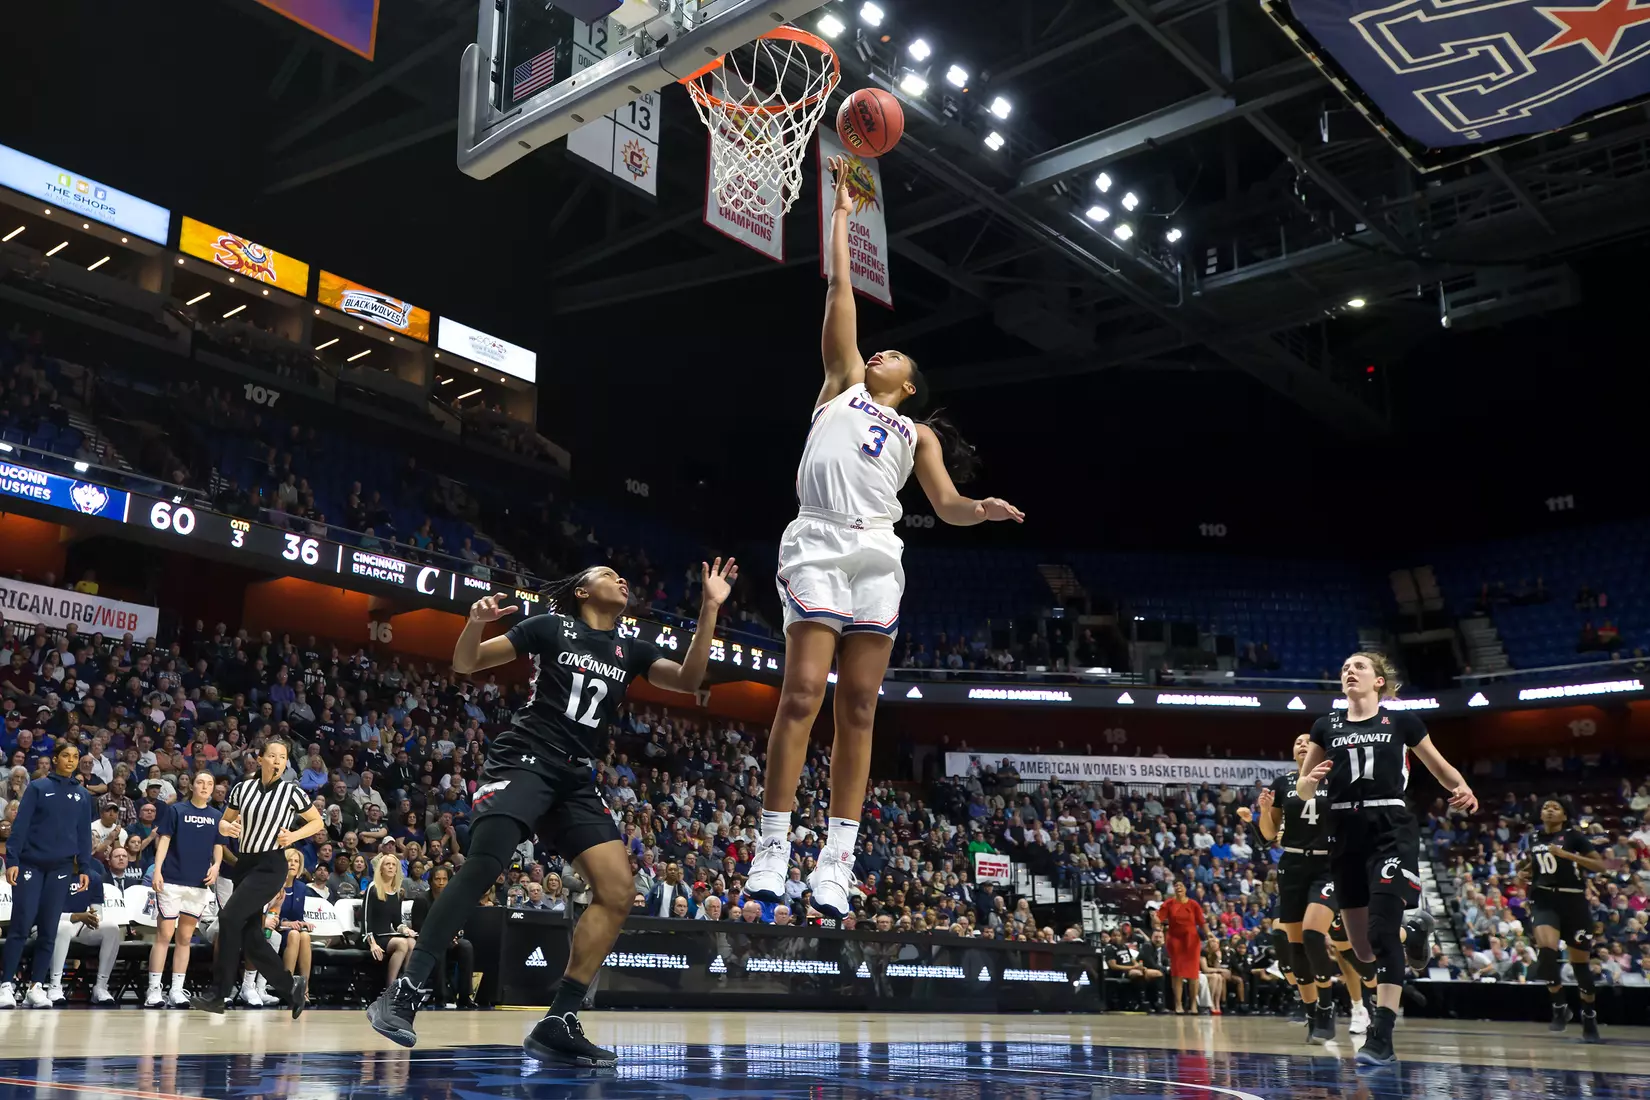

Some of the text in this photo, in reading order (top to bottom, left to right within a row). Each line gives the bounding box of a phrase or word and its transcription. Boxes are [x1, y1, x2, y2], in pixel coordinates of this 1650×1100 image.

[628, 100, 651, 131] 13
[45, 182, 116, 215] THE SHOPS
[719, 206, 772, 242] CHAMPIONS
[850, 221, 870, 240] 2004
[848, 233, 878, 257] ASTERN
[850, 260, 885, 287] AMPIONS
[243, 383, 280, 408] 107
[849, 396, 914, 447] UCONN
[861, 425, 888, 458] 3
[0, 464, 48, 485] UCONN
[0, 477, 52, 501] USKIES
[625, 478, 649, 497] 108
[150, 501, 196, 535] 60
[230, 519, 250, 533] QTR
[904, 514, 936, 529] 109
[231, 529, 244, 548] 3
[1199, 523, 1227, 537] 110
[281, 533, 319, 566] 36
[353, 551, 406, 574] CINCINNATI
[352, 562, 404, 584] BEARCATS
[416, 566, 440, 595] C
[464, 577, 491, 591] BONUS
[515, 589, 539, 603] FOULS
[523, 600, 530, 616] 1
[367, 621, 393, 643] 16
[563, 620, 574, 628] RJ
[662, 626, 672, 635] FT
[655, 633, 678, 650] 4-6
[709, 646, 725, 662] 25
[732, 652, 742, 666] 4
[752, 656, 761, 670] 2
[557, 651, 627, 683] CINCINNATI
[563, 672, 608, 729] 12
[1568, 718, 1597, 737] 19
[1331, 732, 1392, 748] CINCINNATI
[995, 760, 1016, 769] TE
[1019, 760, 1080, 774] AMERICAN
[1082, 763, 1137, 777] WOMEN'S
[1140, 764, 1211, 779] BASKETBALL
[1346, 746, 1375, 784] 11
[184, 815, 215, 825] UCONN
[1300, 798, 1320, 825] 4
[978, 861, 1009, 878] ESPN
[1536, 852, 1557, 875] 10
[820, 918, 836, 927] POSS
[525, 958, 548, 967] adidas
[618, 952, 690, 969] BASKETBALL
[746, 957, 782, 972] ADIDAS
[783, 959, 841, 975] BASKETBALL
[886, 963, 917, 977] ADIDAS
[917, 965, 966, 979] BASKETBALL
